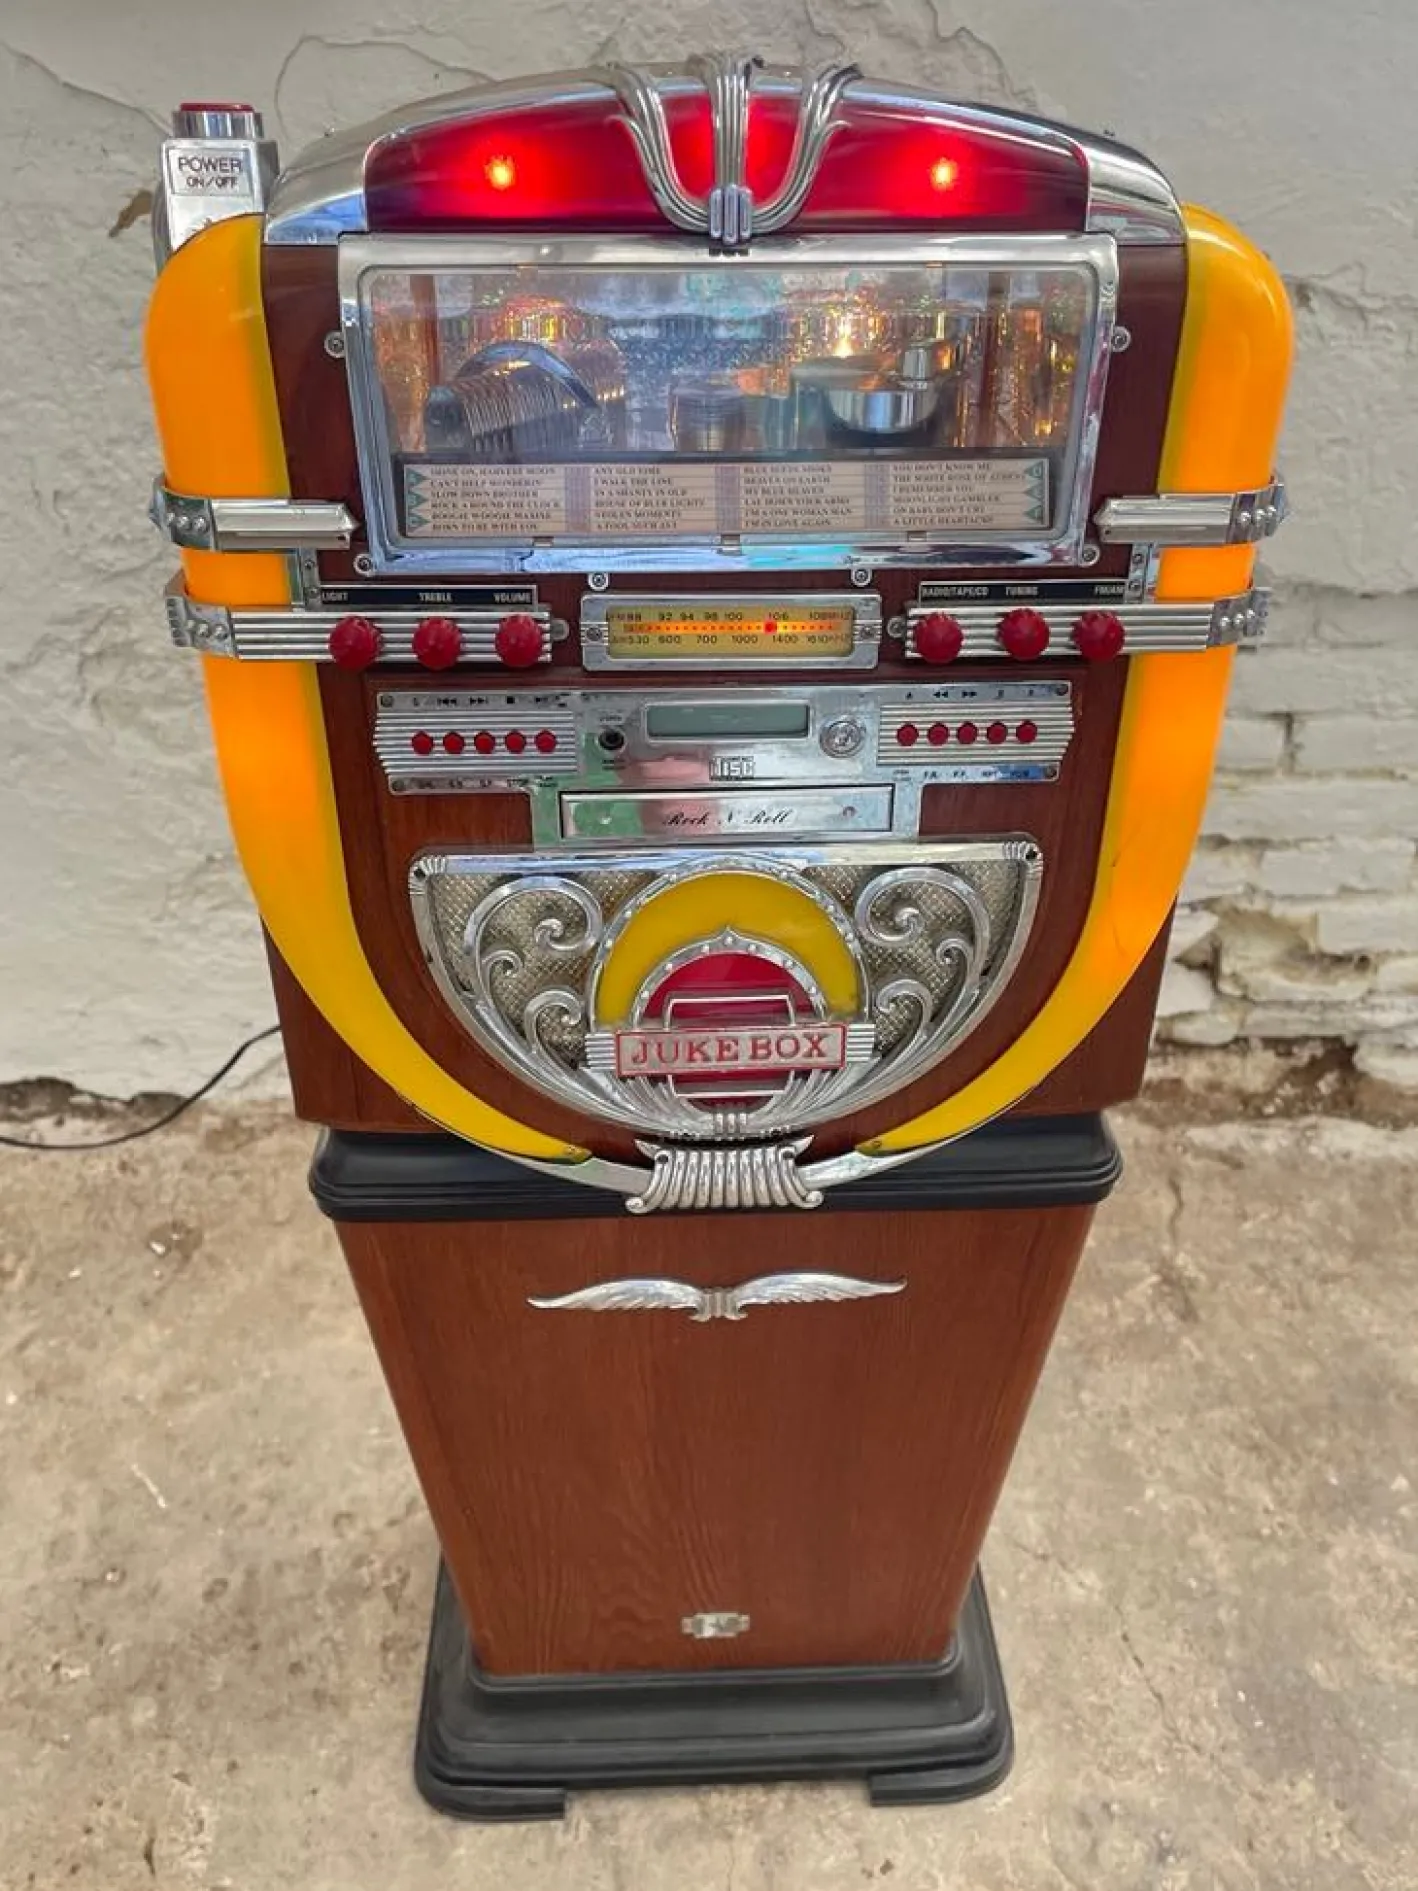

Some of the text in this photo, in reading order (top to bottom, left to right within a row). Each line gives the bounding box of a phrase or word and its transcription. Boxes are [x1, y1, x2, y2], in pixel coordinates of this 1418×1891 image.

[178, 157, 242, 173] POWER
[186, 177, 237, 188] ON/OFF
[1005, 586, 1038, 596] TUNING
[322, 592, 531, 602] LIGHT TREBLE VOLUME
[680, 612, 694, 621] 94
[725, 612, 742, 621] 100
[768, 612, 789, 621] 106
[658, 635, 681, 644] 600
[696, 635, 718, 644] 700
[731, 634, 758, 644] 1000
[772, 634, 798, 644] 1400
[662, 811, 710, 825] Rock
[744, 809, 793, 825] Roll
